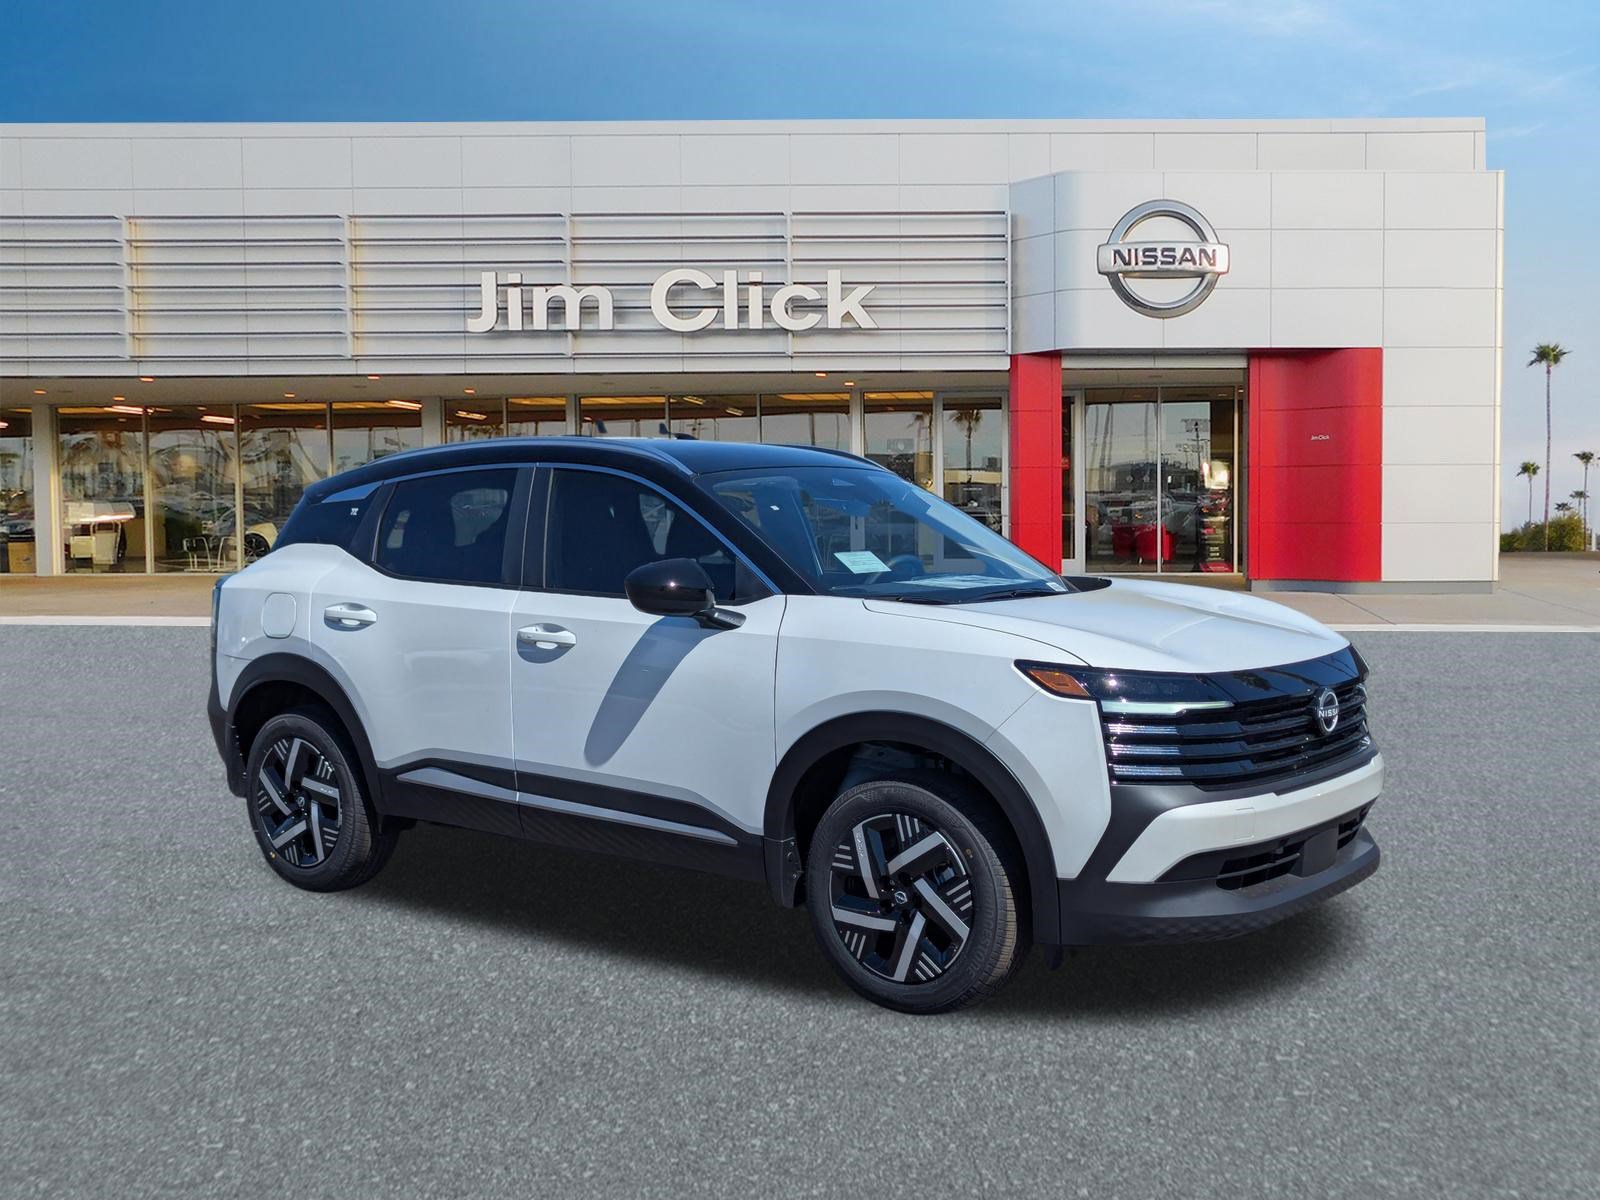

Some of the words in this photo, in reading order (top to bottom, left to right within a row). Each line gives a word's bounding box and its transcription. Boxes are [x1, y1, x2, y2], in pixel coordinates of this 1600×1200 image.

[1112, 247, 1217, 266] NISSAN
[466, 271, 614, 333] Jim
[650, 268, 880, 332] Click
[1318, 708, 1338, 718] NISS
